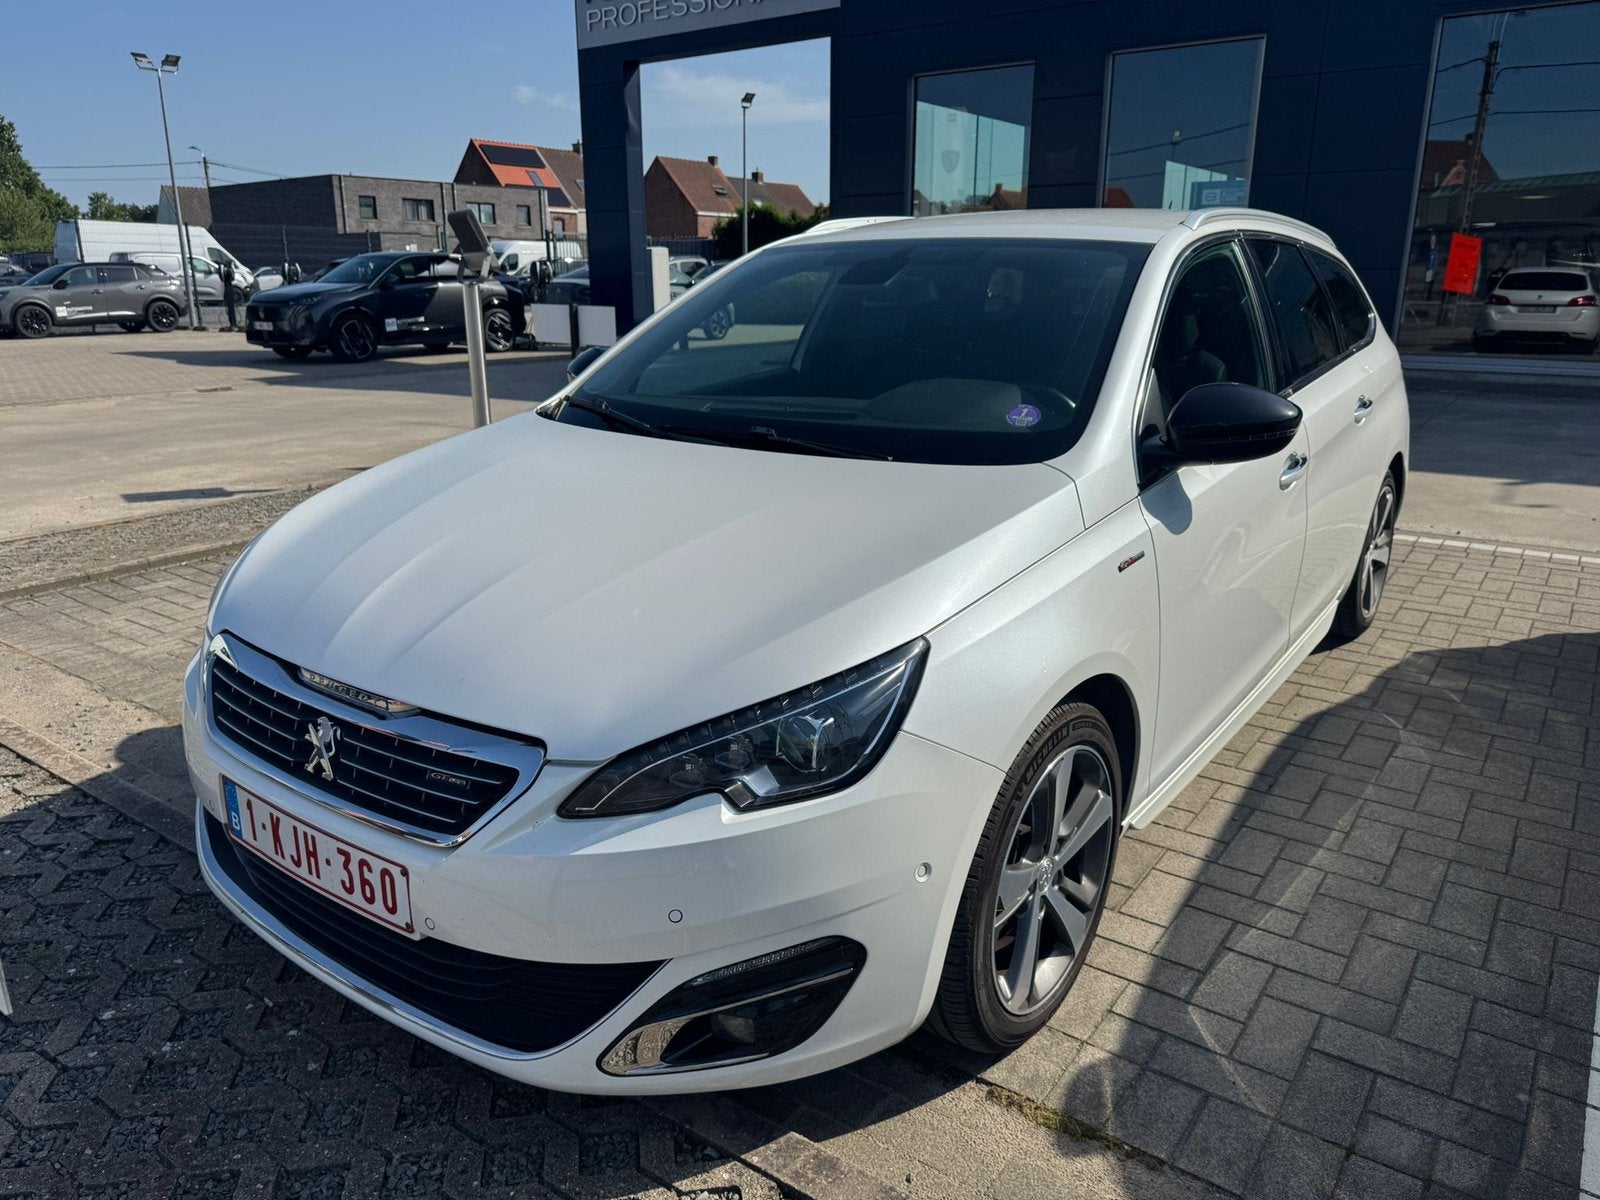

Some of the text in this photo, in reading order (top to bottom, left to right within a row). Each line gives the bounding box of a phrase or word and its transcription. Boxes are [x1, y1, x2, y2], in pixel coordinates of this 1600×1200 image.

[586, 0, 760, 31] PROFESSI
[1023, 724, 1070, 786] MICHELIN
[231, 811, 241, 831] B
